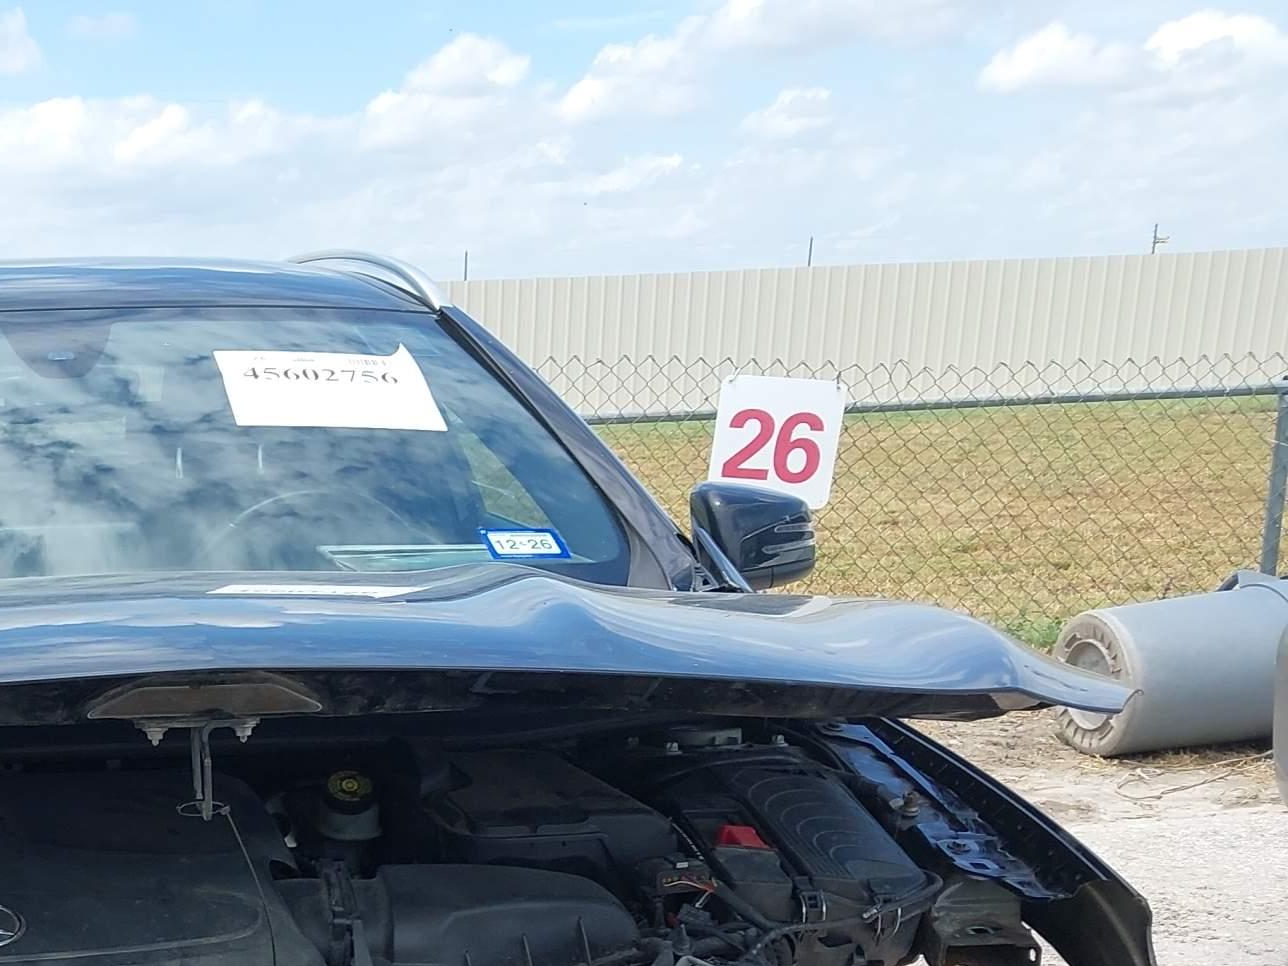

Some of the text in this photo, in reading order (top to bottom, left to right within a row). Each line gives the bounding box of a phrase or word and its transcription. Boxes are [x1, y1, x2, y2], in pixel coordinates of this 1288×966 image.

[243, 367, 398, 384] 45602756
[721, 408, 825, 484] 26
[495, 539, 553, 550] 12-26
